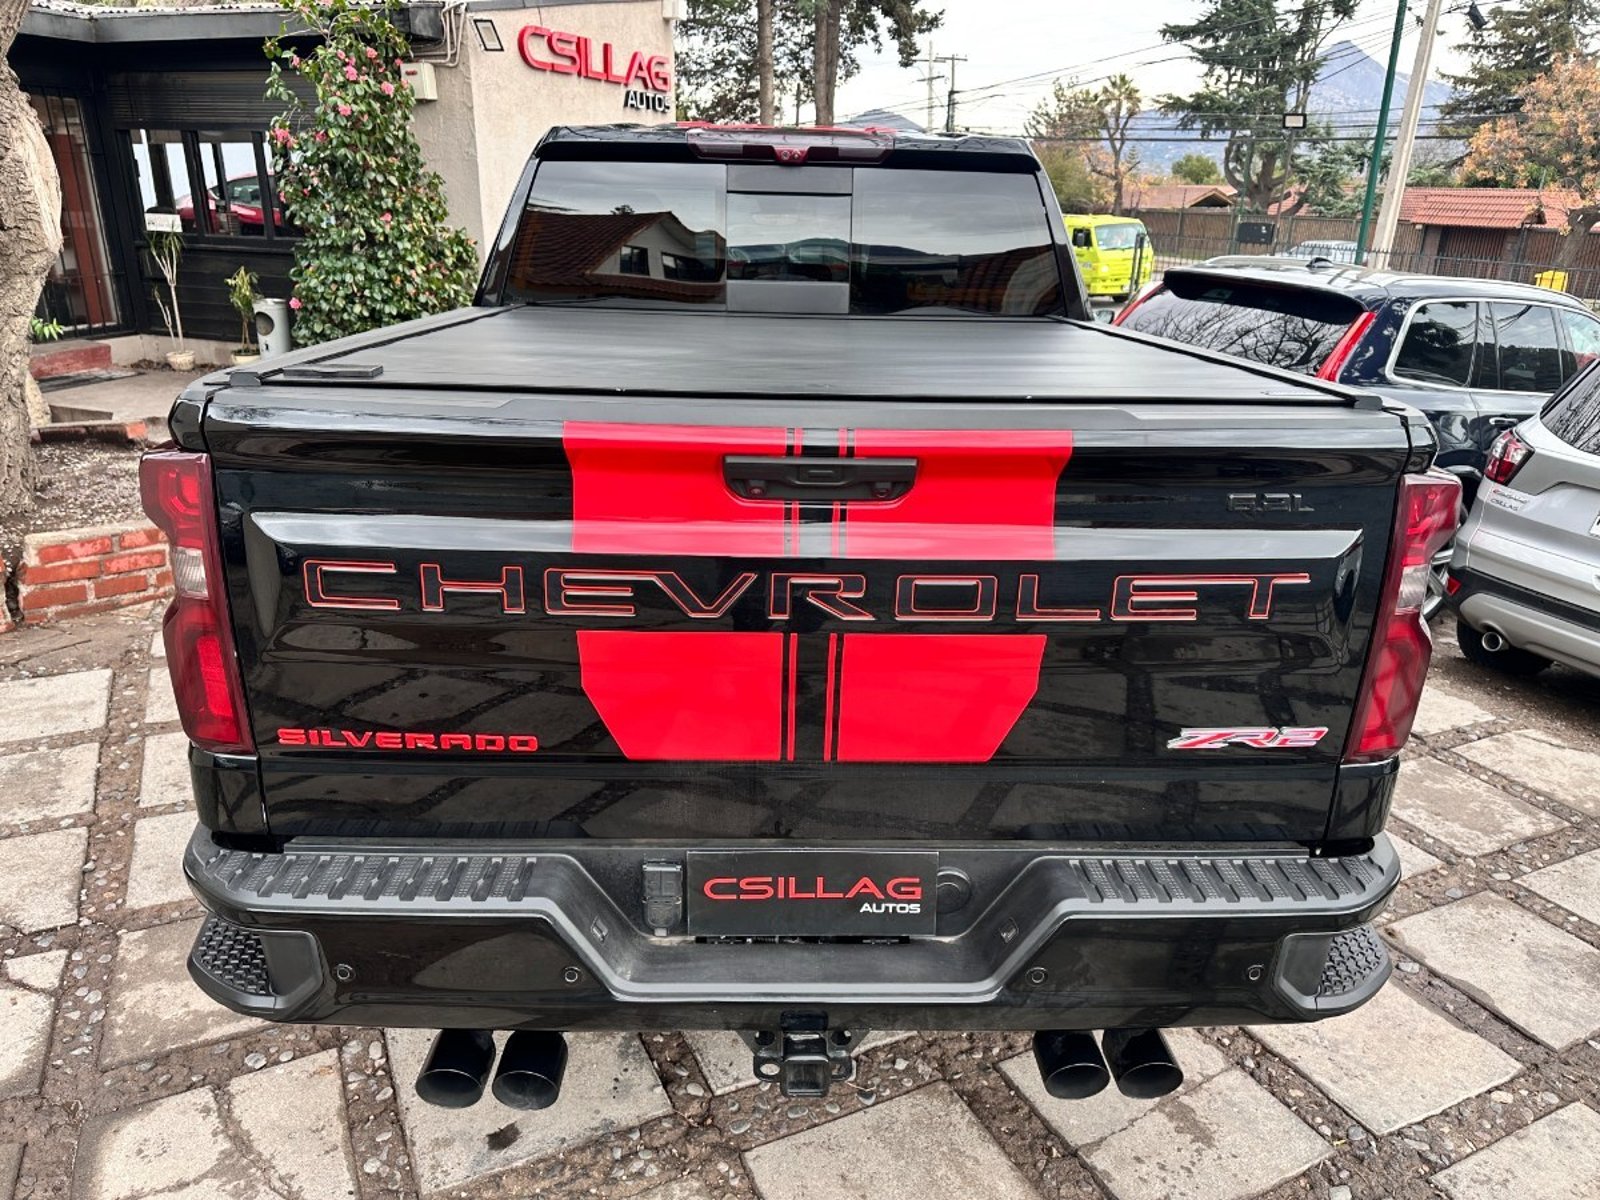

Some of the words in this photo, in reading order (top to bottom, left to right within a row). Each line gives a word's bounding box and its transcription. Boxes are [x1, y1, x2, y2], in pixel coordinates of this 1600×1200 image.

[518, 25, 671, 92] CSILLAG
[624, 90, 671, 113] AUTOS
[303, 559, 1311, 622] CHEVROLET
[277, 728, 539, 751] SILVERADO
[1167, 726, 1329, 749] ZR2
[703, 876, 922, 900] CSILLAG
[859, 902, 921, 914] AUTOS
